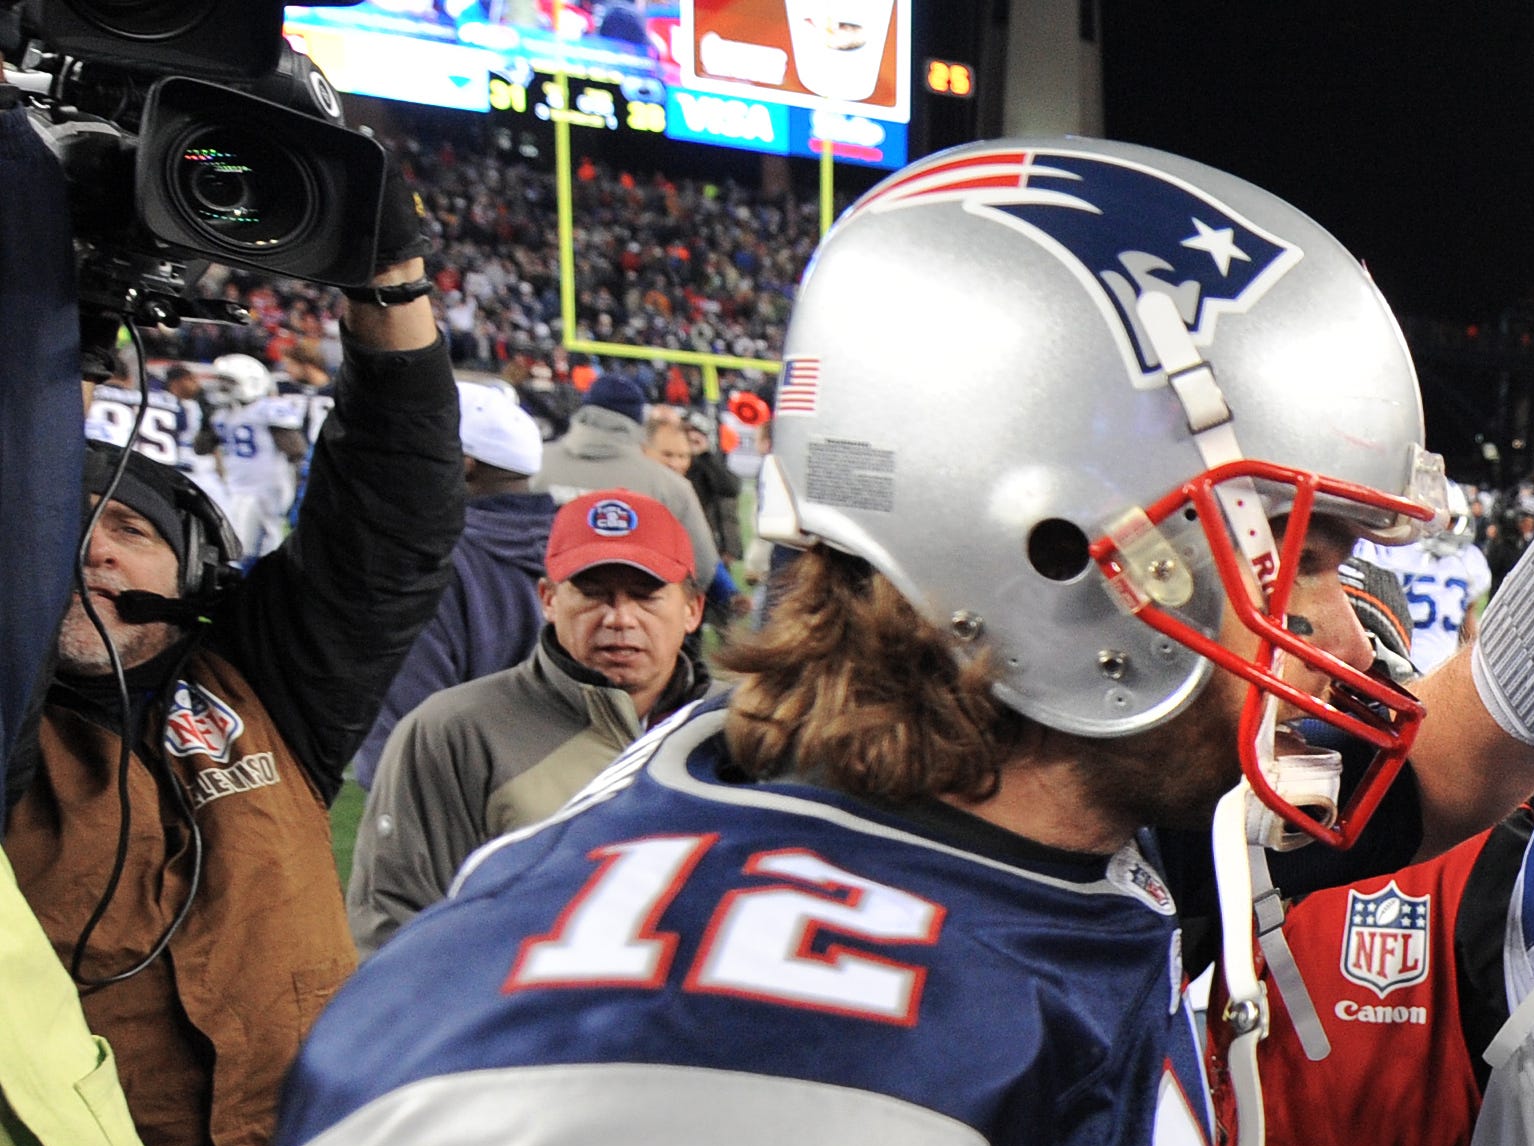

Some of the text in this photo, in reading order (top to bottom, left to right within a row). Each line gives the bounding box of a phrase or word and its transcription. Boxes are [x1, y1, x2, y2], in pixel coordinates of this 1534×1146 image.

[675, 92, 775, 143] VISA
[1403, 573, 1469, 632] 53
[501, 832, 948, 1028] 12
[1352, 930, 1419, 980] NFL
[1334, 999, 1427, 1025] Canon
